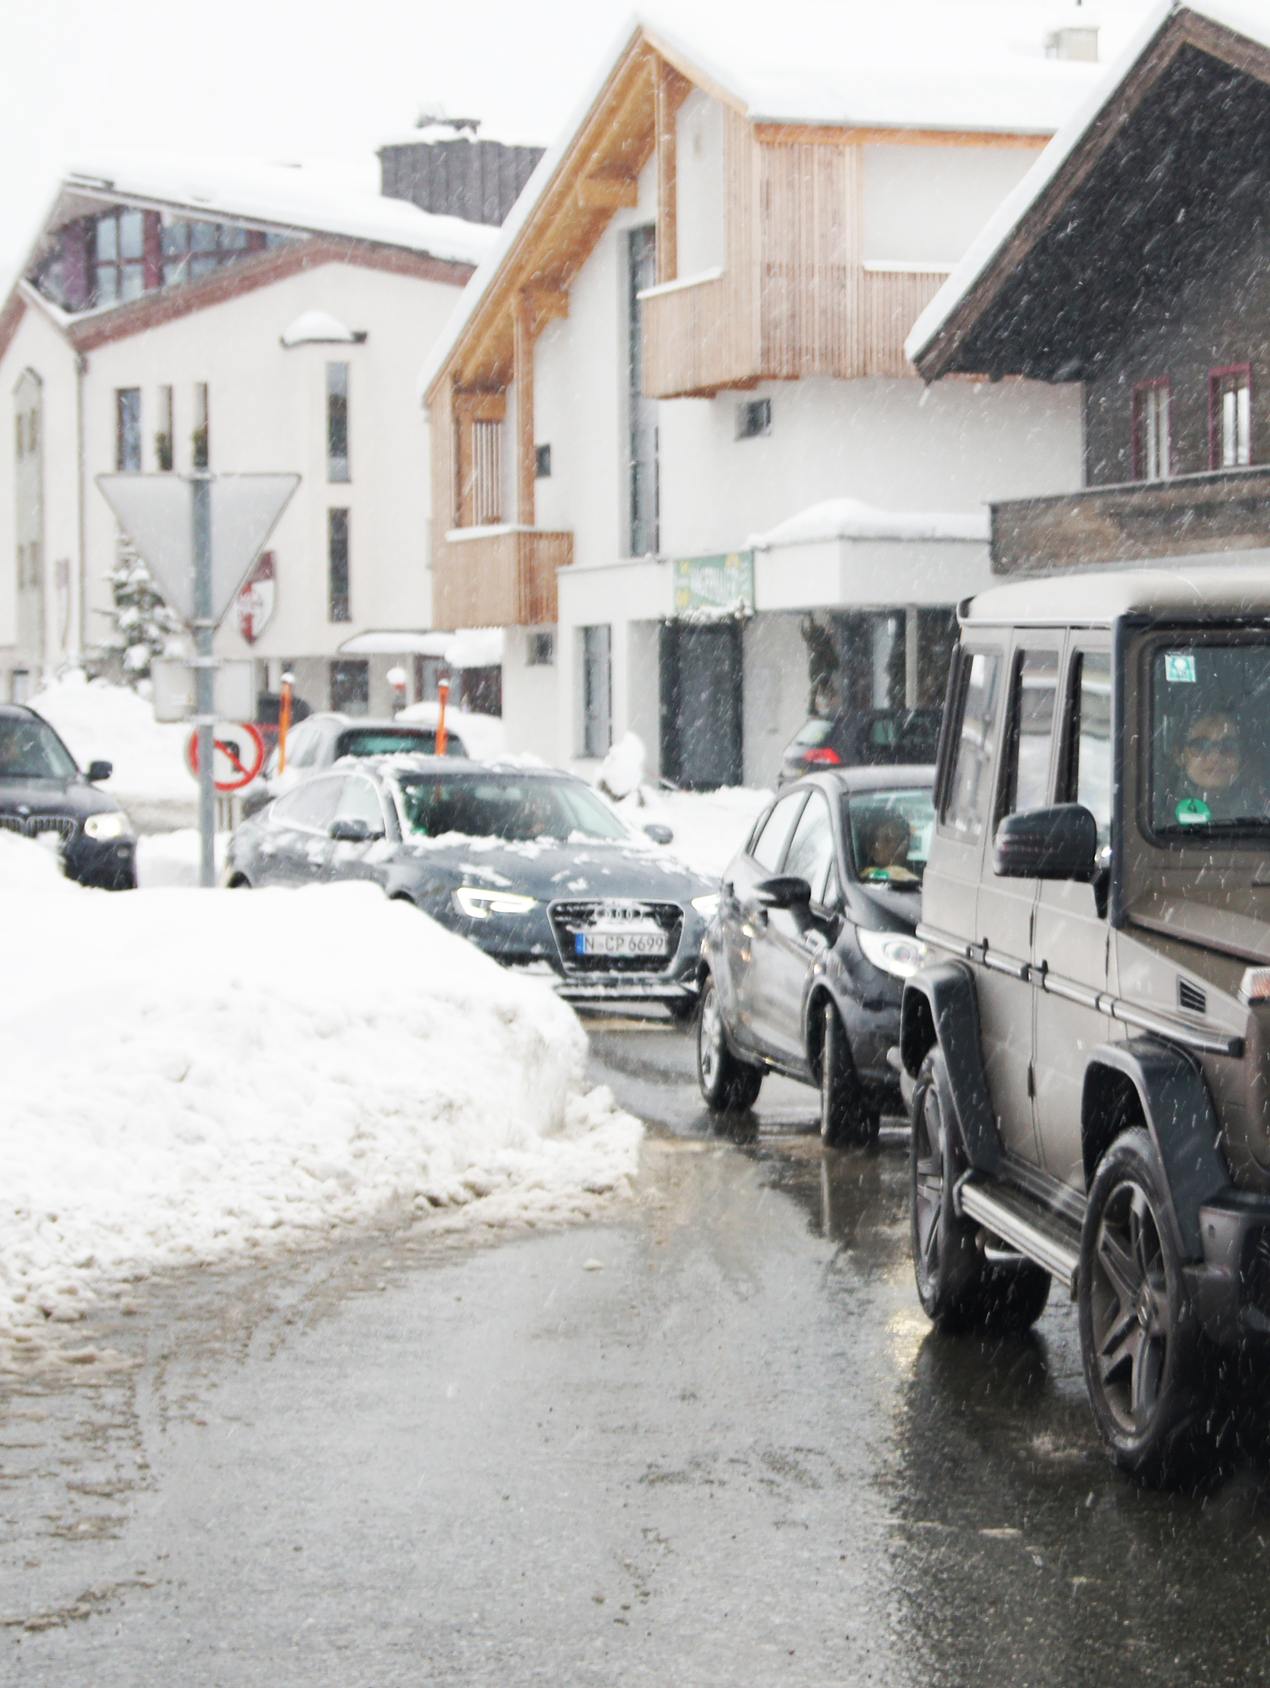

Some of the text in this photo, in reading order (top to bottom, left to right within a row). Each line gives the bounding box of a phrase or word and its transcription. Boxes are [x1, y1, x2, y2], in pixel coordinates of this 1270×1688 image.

[585, 936, 664, 951] N CP 6699
